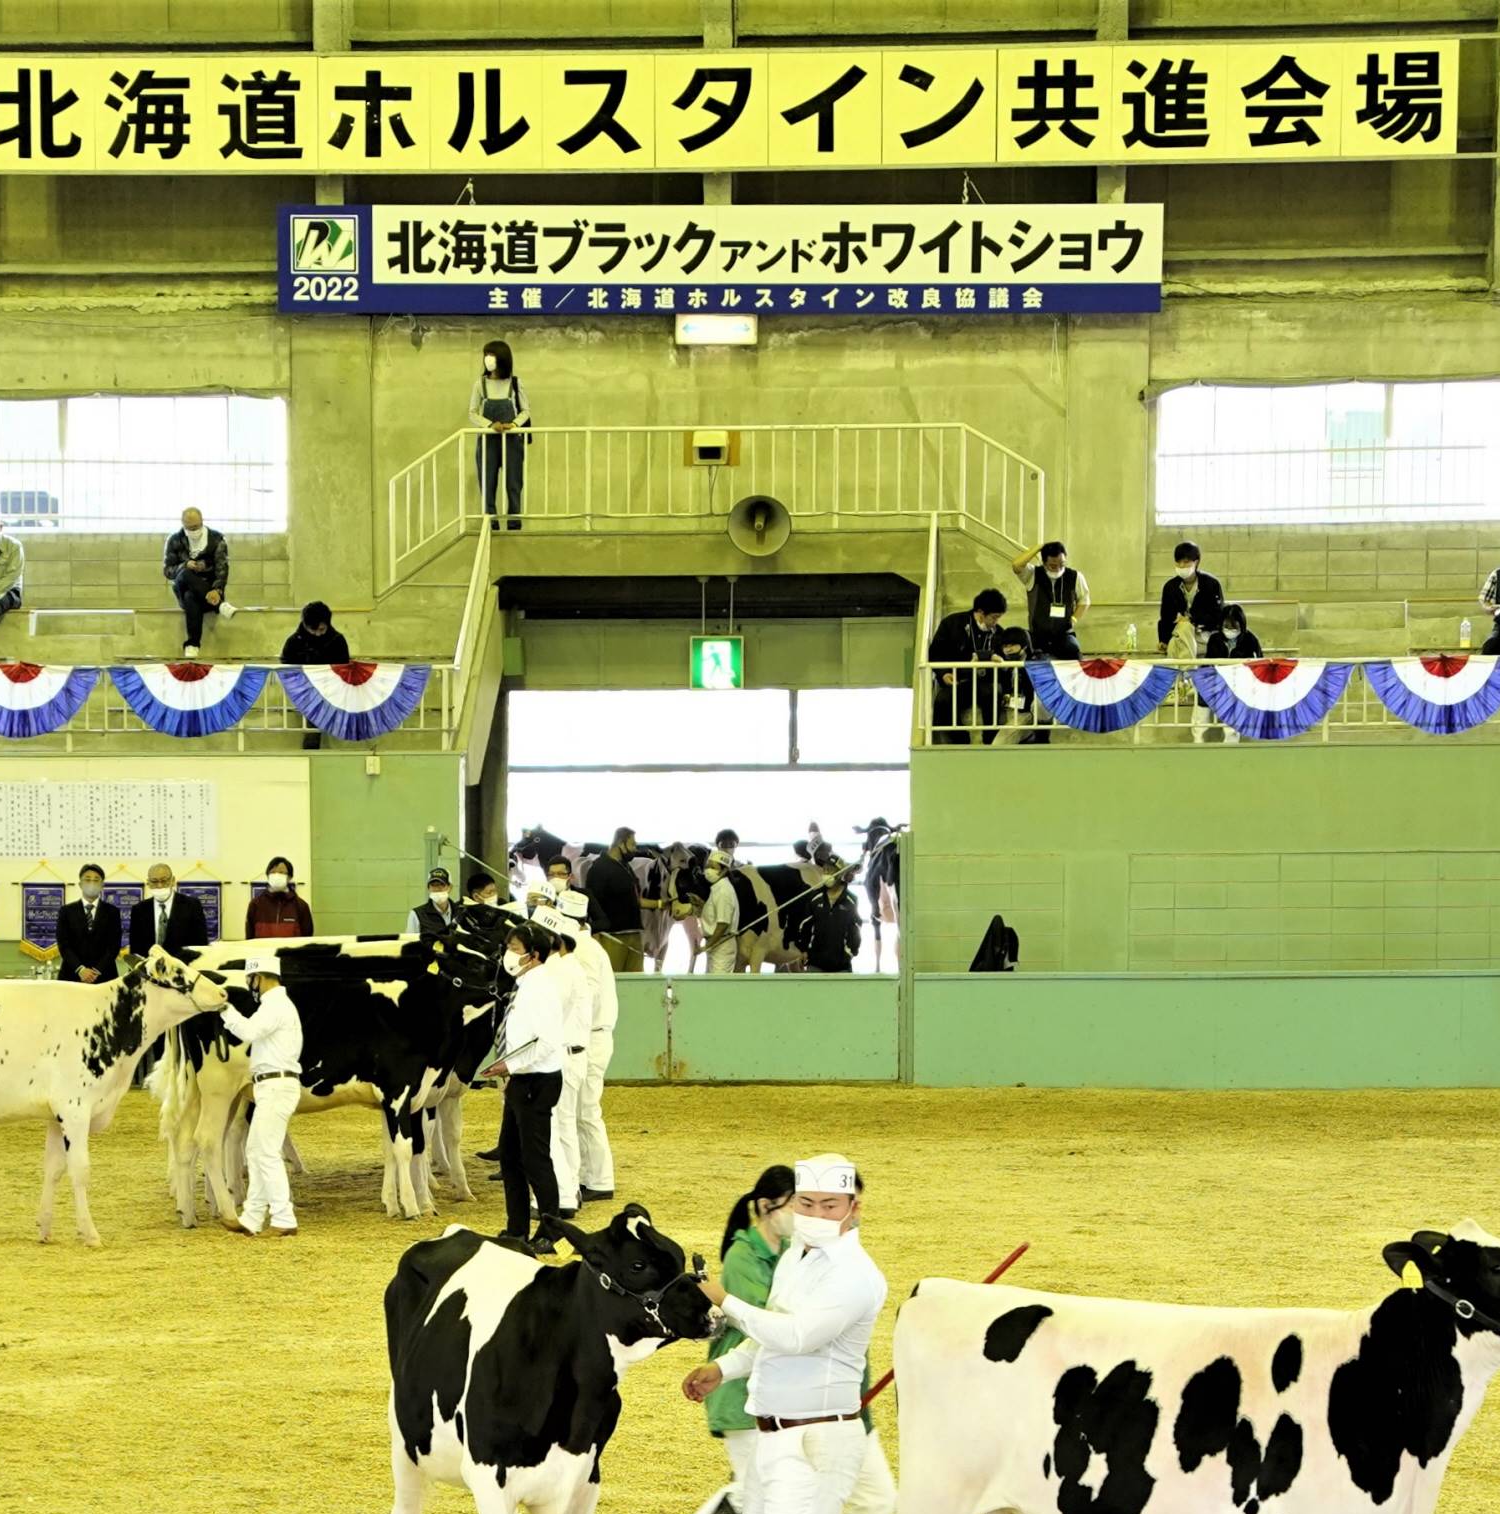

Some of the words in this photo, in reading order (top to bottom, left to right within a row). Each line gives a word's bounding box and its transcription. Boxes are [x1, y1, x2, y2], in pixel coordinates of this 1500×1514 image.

[386, 219, 1144, 277] 北海道ブラックアンドホワイトショウ
[293, 276, 359, 301] 2022
